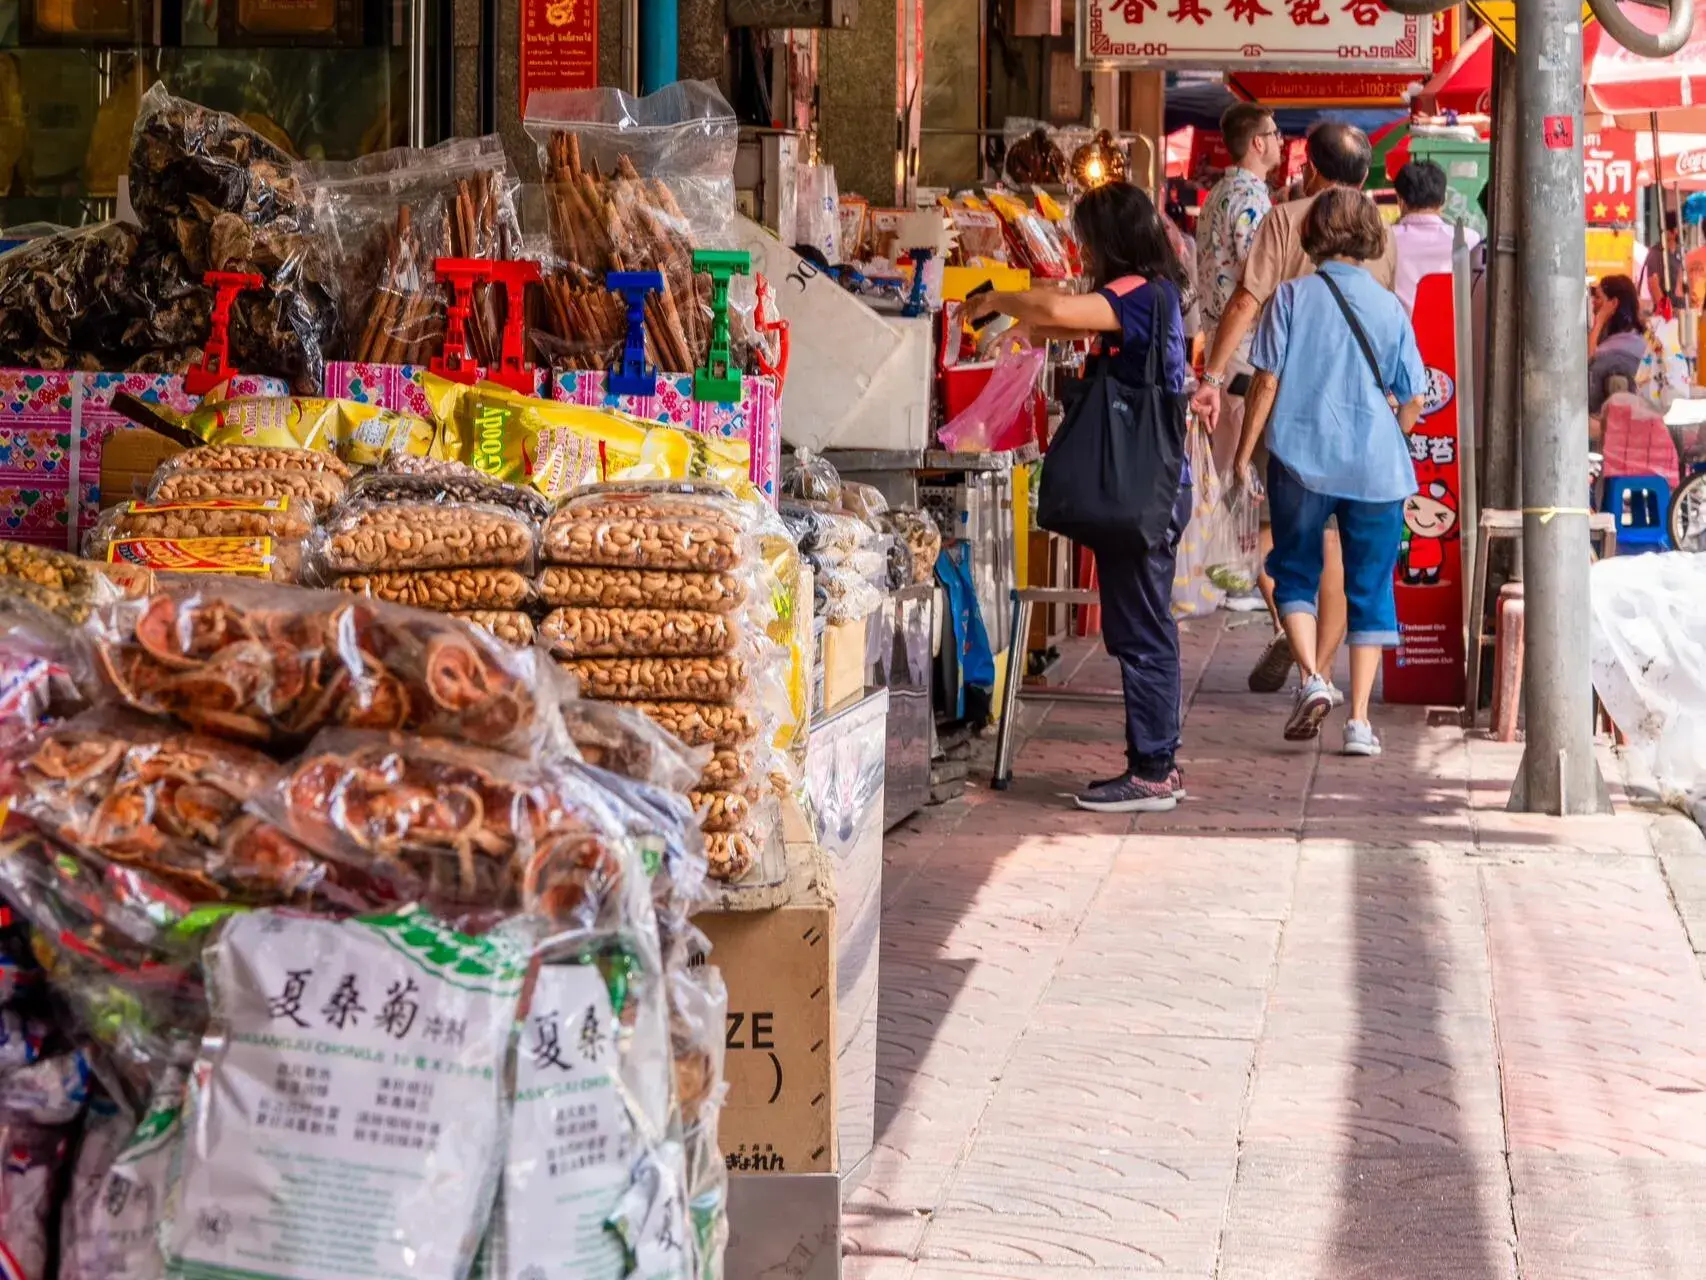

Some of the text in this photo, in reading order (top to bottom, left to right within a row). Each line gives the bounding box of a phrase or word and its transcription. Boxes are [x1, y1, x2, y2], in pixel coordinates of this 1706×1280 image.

[473, 407, 511, 474] Goody
[269, 969, 421, 1039] 夏桑菊
